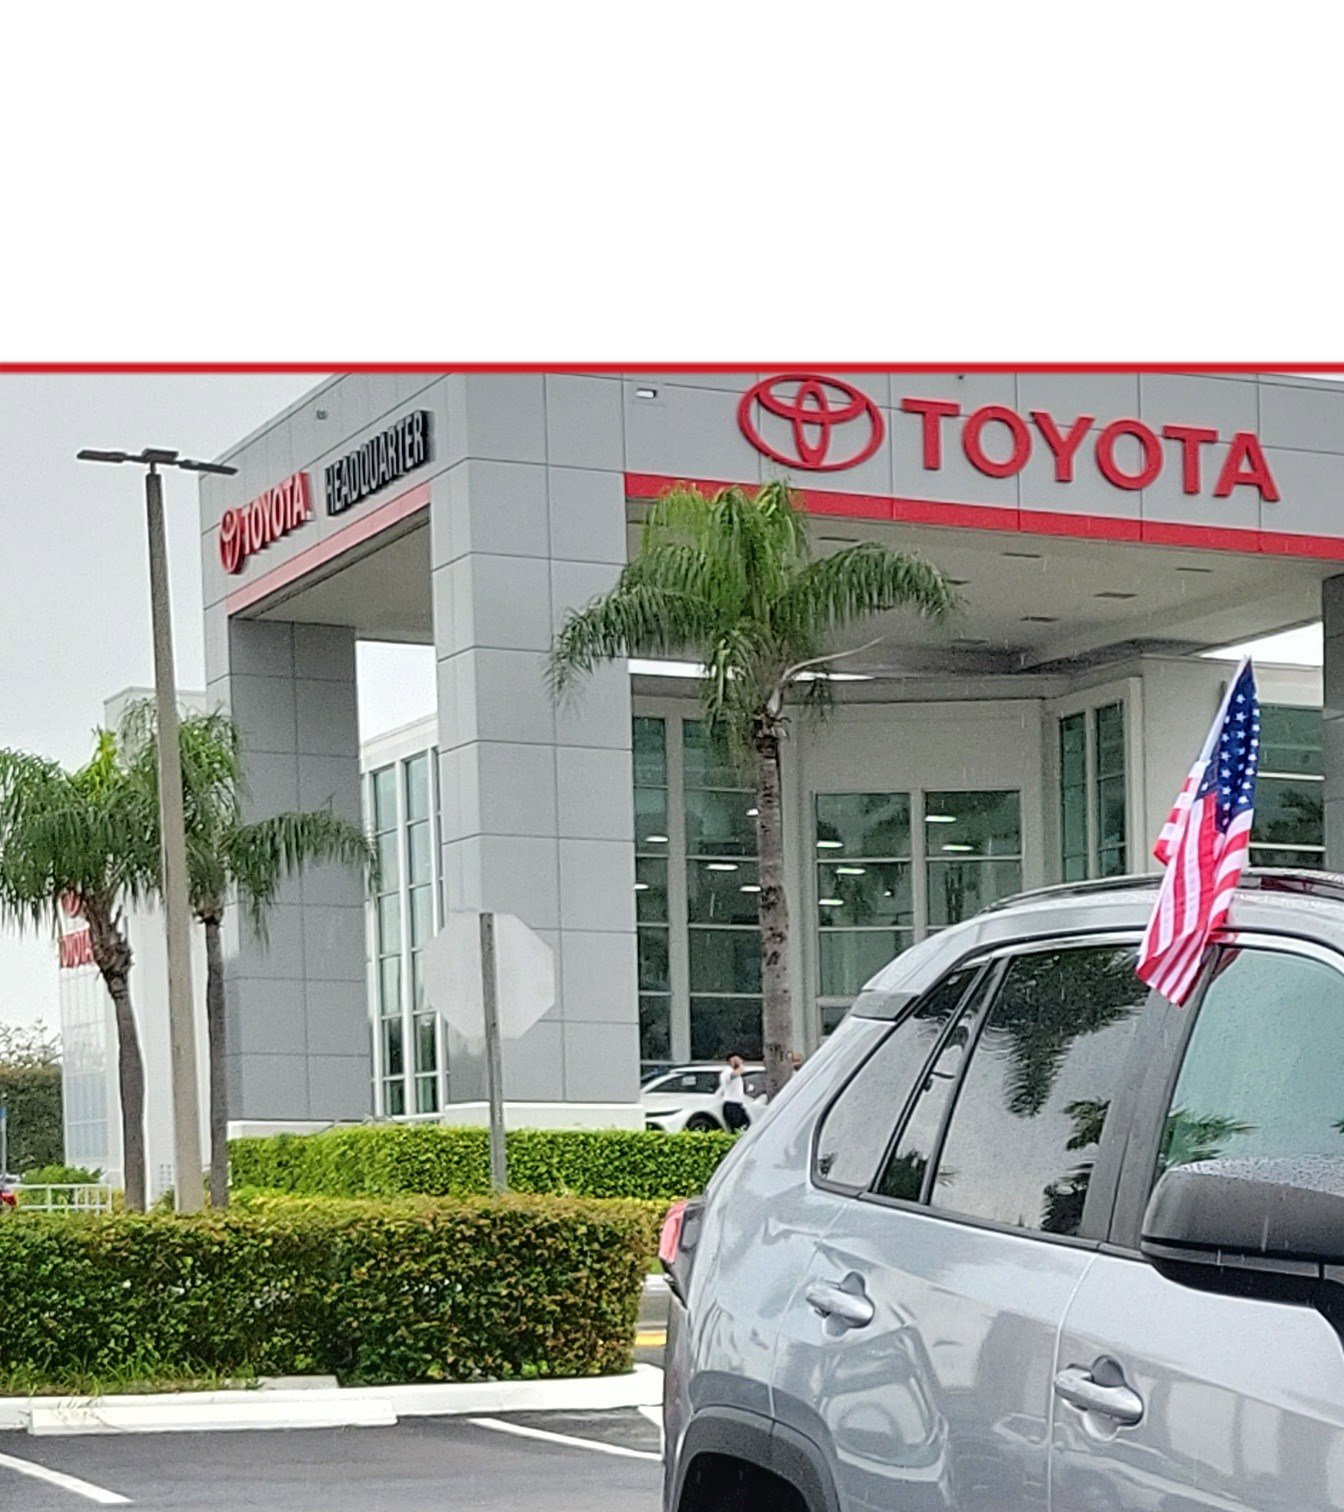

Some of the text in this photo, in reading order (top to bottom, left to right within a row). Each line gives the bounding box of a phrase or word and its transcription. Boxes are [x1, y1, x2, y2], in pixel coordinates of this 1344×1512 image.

[240, 409, 430, 555] TOYOTA HEADQUARTER
[902, 397, 1280, 502] TOYOTA
